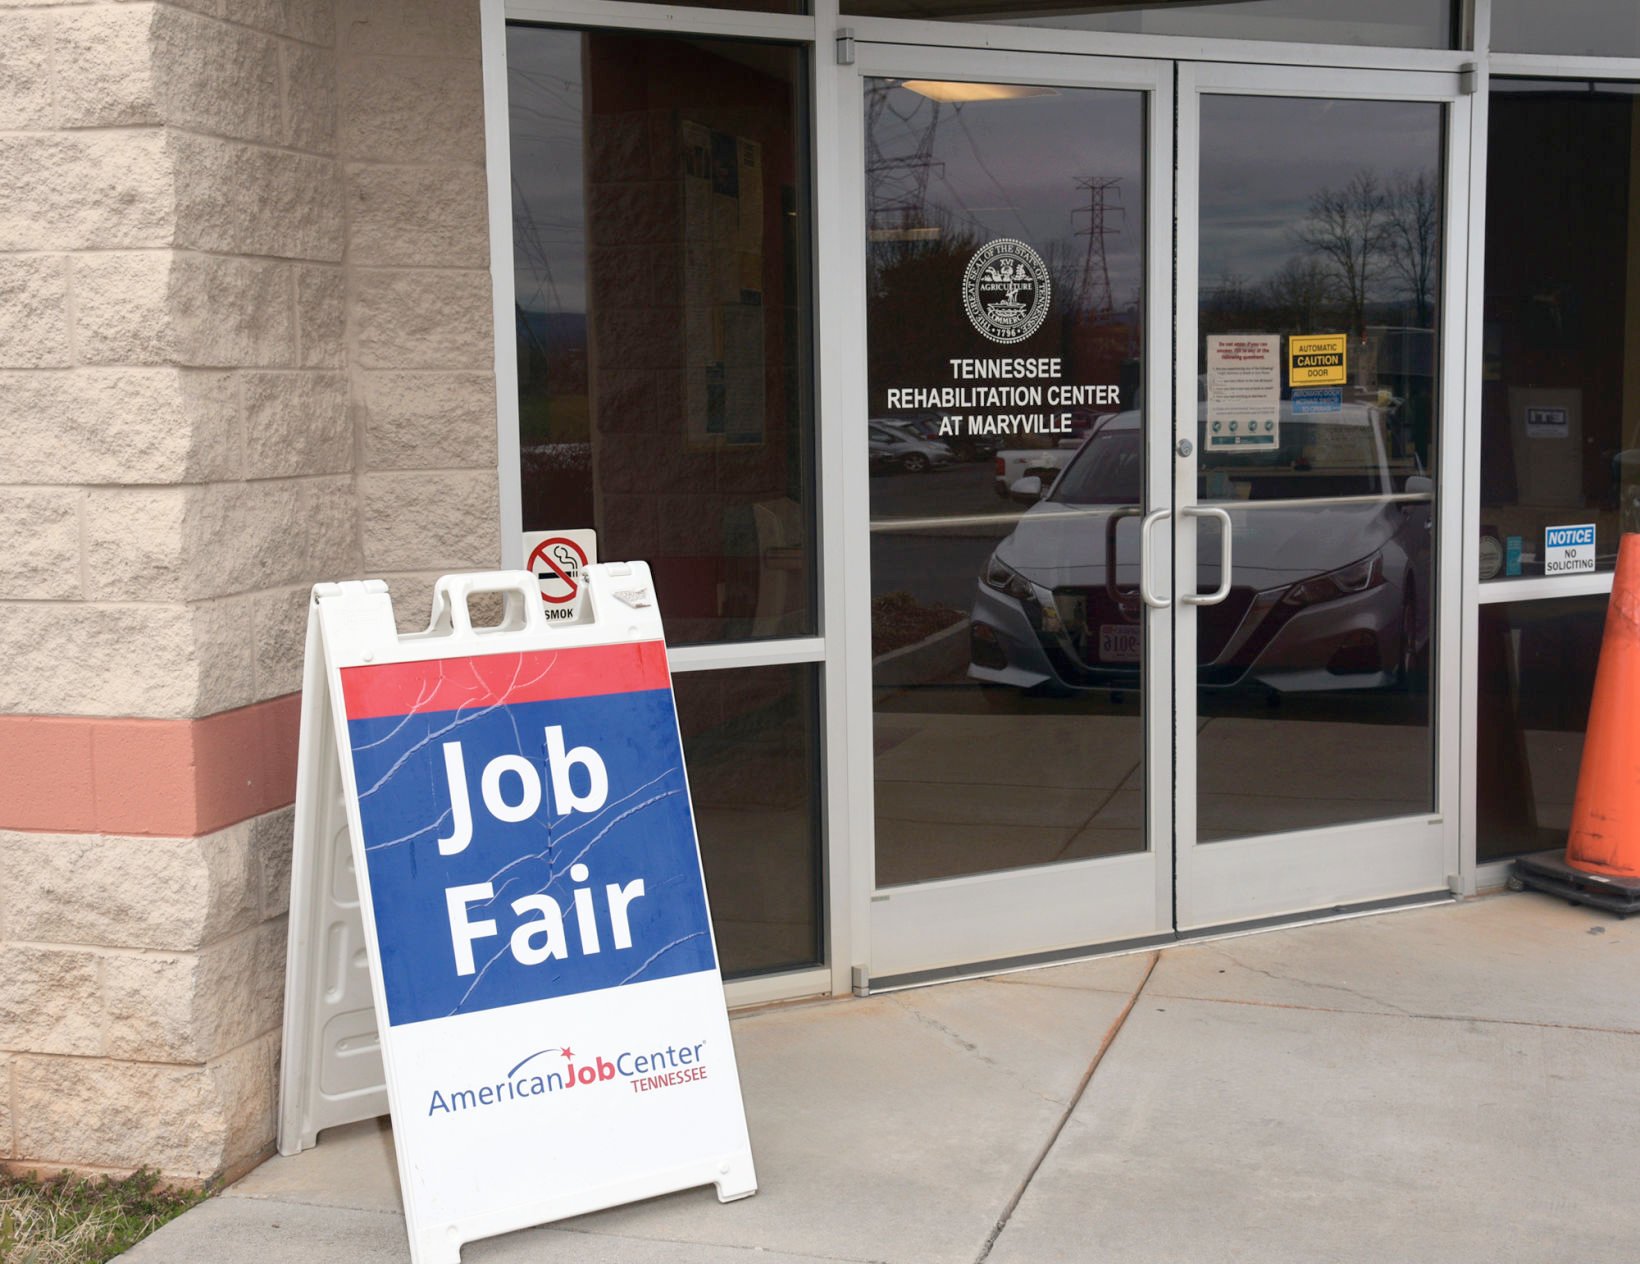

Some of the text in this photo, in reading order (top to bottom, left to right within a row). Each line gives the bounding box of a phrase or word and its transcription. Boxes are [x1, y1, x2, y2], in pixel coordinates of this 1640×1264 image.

[994, 245, 1014, 254] THE
[969, 258, 987, 280] SEAL
[999, 259, 1014, 267] XVI
[967, 280, 980, 315] GREAT
[996, 329, 1016, 338] 1796
[1299, 344, 1337, 352] AUTOMATIC
[950, 358, 1062, 379] TENNESSEE
[1297, 355, 1338, 366] CAUTION
[1308, 369, 1328, 377] DOOR
[887, 385, 1121, 409] REHABILITATION CENTER
[938, 413, 1073, 436] AT MARYVILLE
[1549, 529, 1593, 545] NOTICE
[1565, 549, 1577, 559] NO
[1547, 559, 1594, 571] SOLICITING
[437, 725, 608, 856] Job
[445, 863, 645, 976] Fair
[630, 1065, 708, 1093] TENNESSEE
